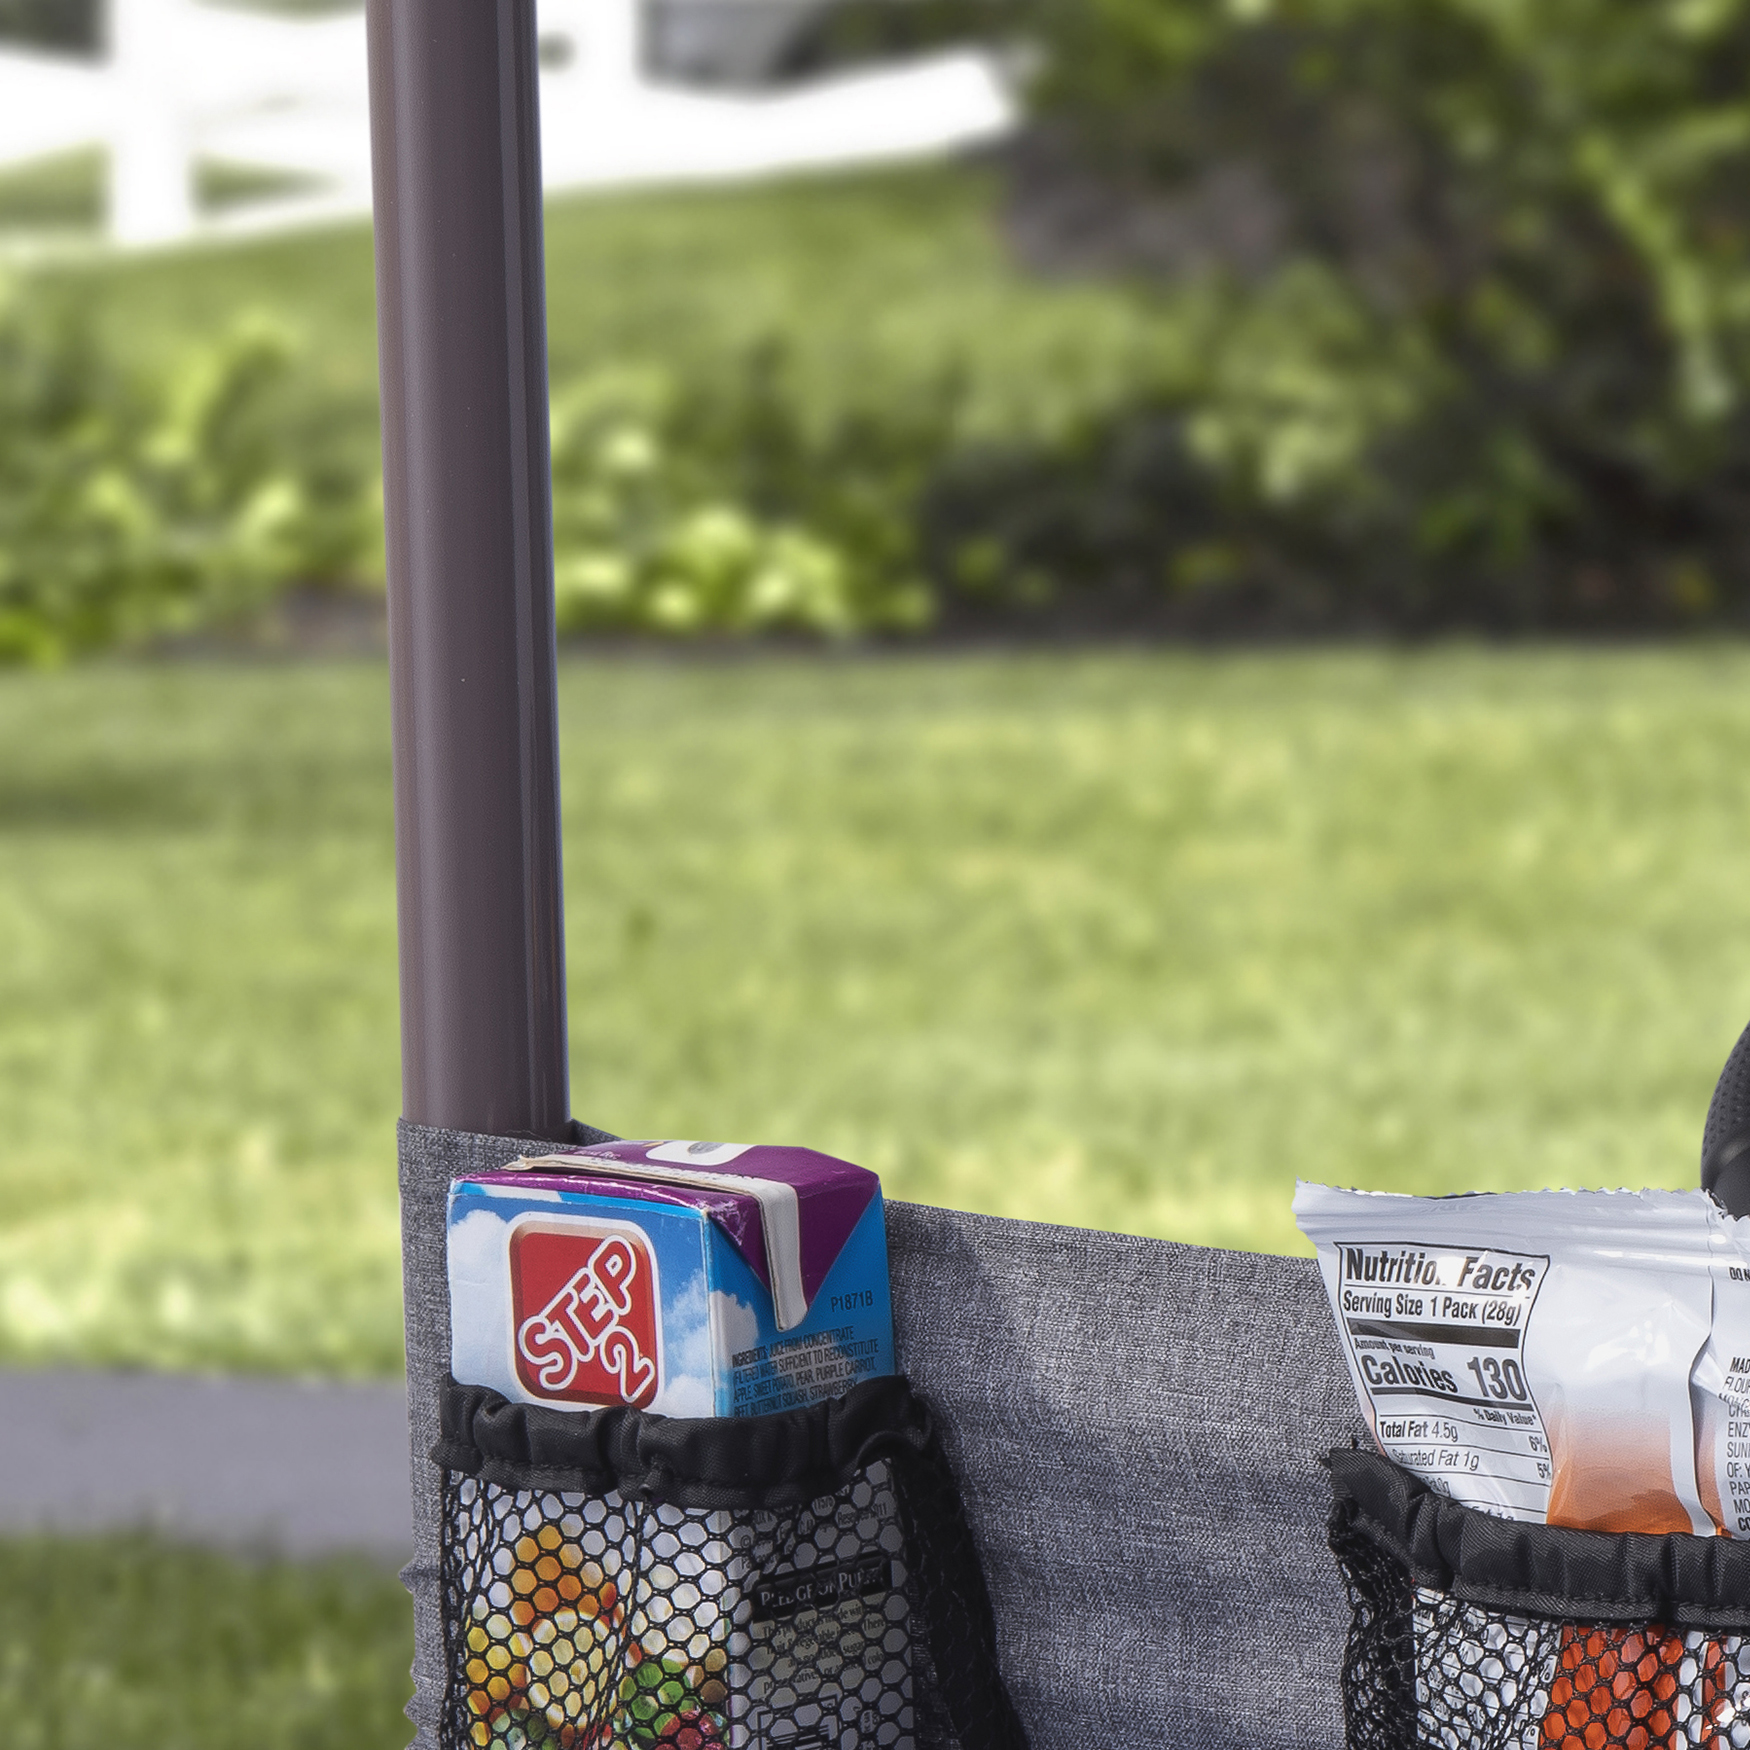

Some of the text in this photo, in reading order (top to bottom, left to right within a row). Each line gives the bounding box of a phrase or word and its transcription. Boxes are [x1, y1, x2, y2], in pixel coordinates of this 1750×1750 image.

[1456, 1256, 1536, 1292] Facts
[1729, 1267, 1742, 1281] DO
[518, 1234, 637, 1391] STEP
[1343, 1290, 1522, 1326] Serving Size 1 Pack (28g)
[803, 1325, 855, 1348] CONCENTRATE
[778, 1350, 812, 1373] SUFFICIENT
[813, 1349, 824, 1365] TO
[825, 1338, 879, 1363] RECONSTITUTE
[1354, 1337, 1435, 1360] Amount per serving
[600, 1326, 655, 1403] 2
[816, 1362, 844, 1381] PURPLE
[1361, 1355, 1528, 1402] Calories 130
[1484, 1410, 1507, 1426] Daily
[1379, 1421, 1458, 1443] Total Fat 4.5g
[1529, 1435, 1548, 1453] 6%
[1438, 1449, 1459, 1467] Fat
[1463, 1451, 1480, 1471] 1g
[1727, 1461, 1743, 1479] OF:
